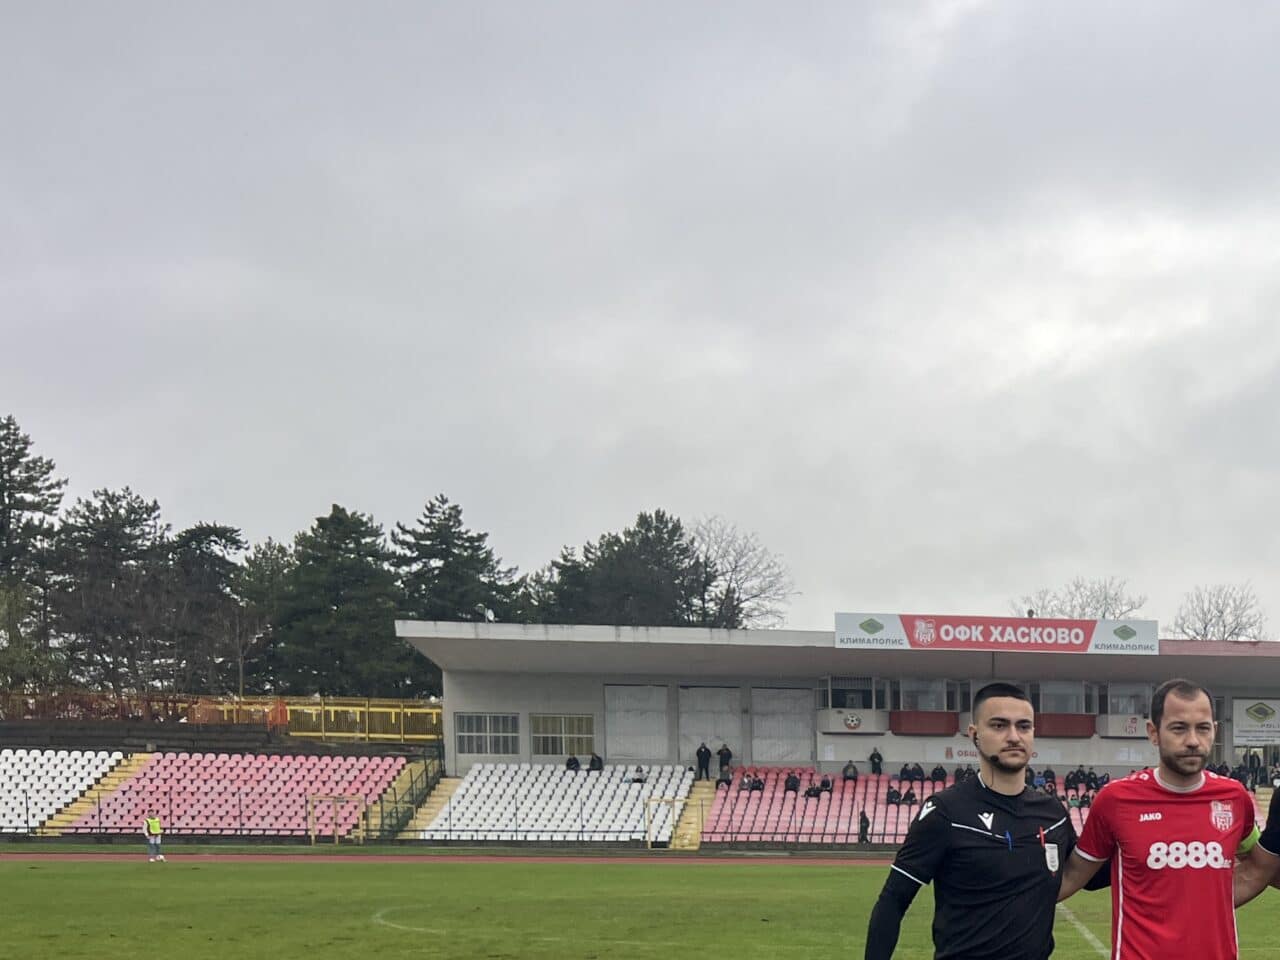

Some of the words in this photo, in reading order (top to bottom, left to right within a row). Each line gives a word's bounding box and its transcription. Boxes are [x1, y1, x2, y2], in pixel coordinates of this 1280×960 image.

[940, 624, 984, 642] ОФК
[989, 625, 1085, 645] ХАСКОВО
[839, 637, 904, 646] КЛИМАПОЛИС
[1094, 642, 1155, 651] КЛИМАПОЛИС
[1139, 812, 1162, 822] JAKO
